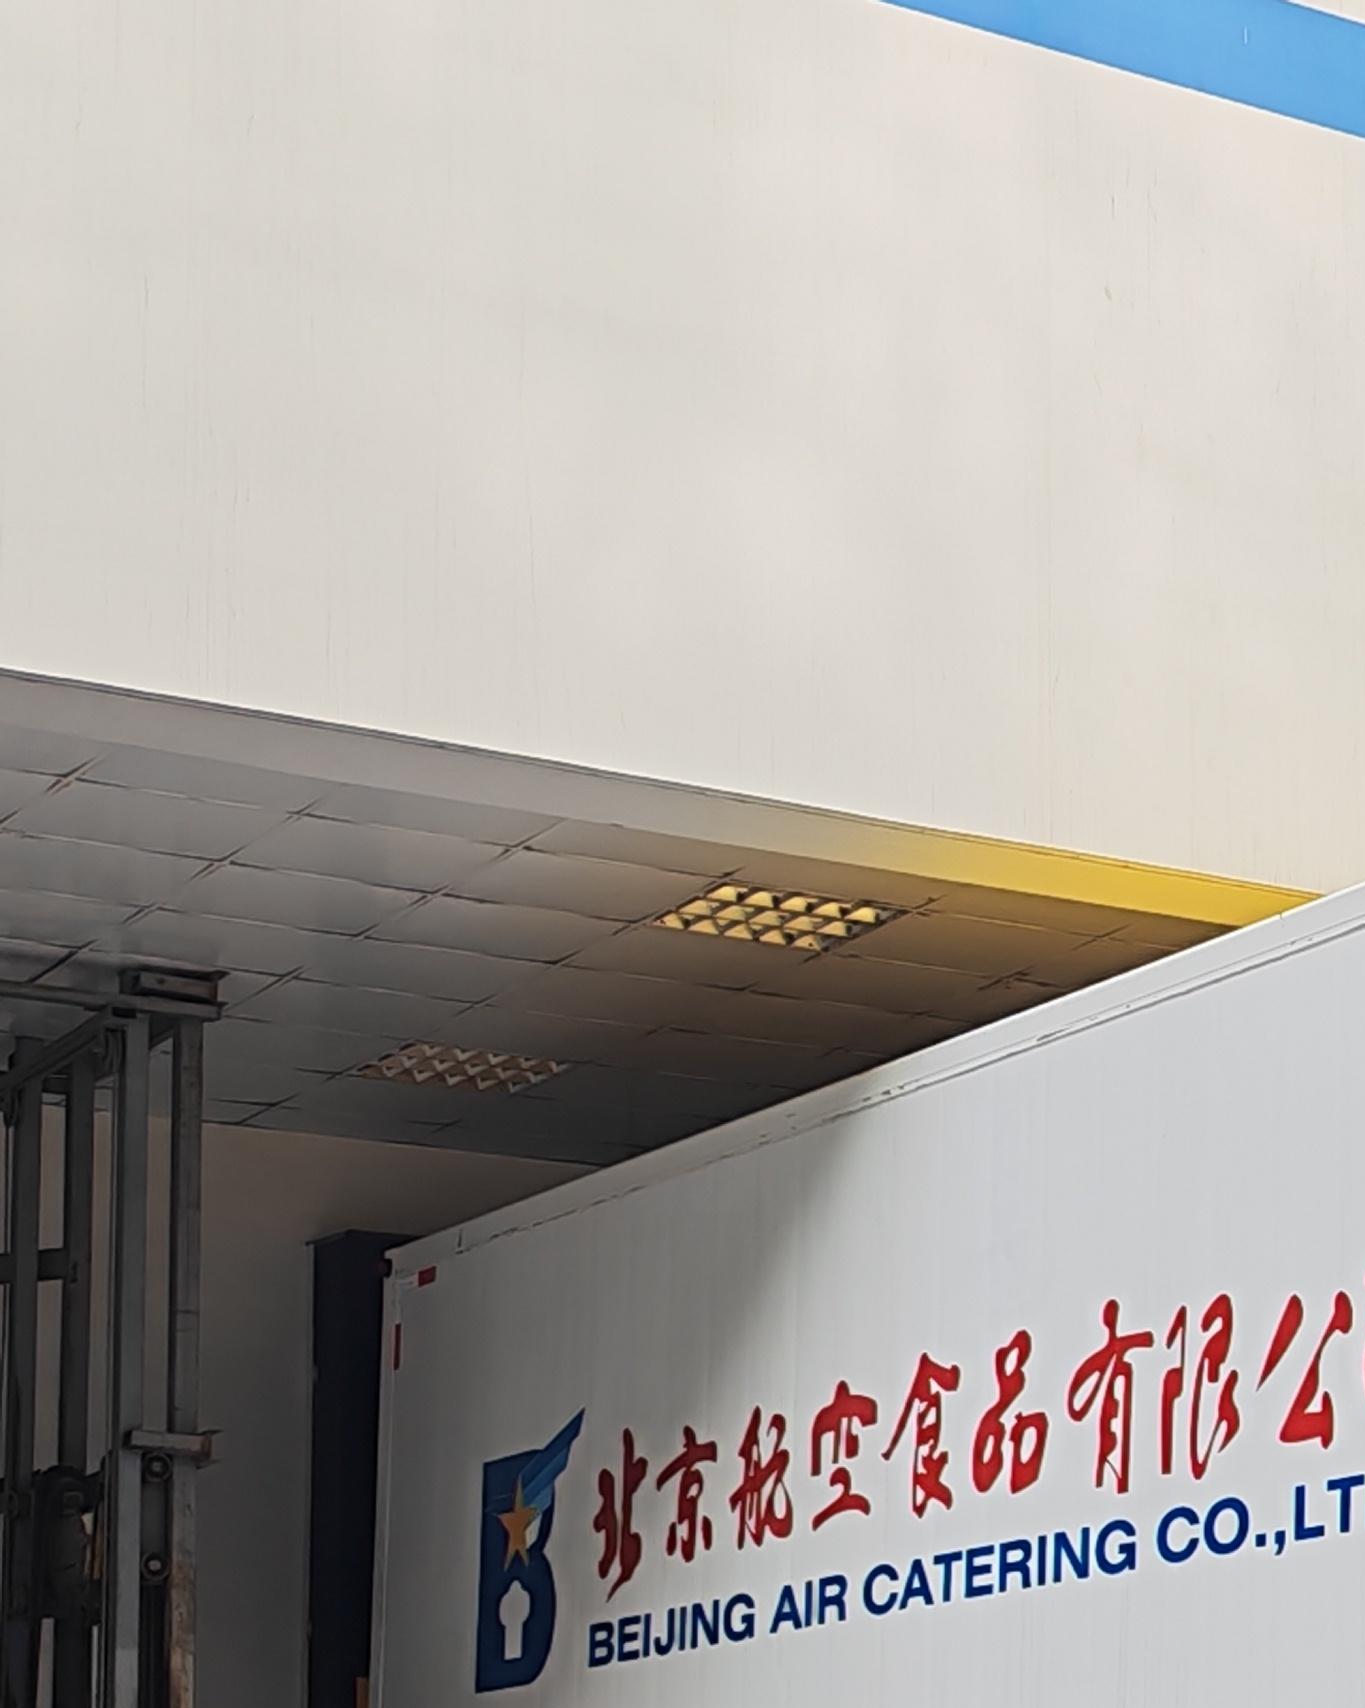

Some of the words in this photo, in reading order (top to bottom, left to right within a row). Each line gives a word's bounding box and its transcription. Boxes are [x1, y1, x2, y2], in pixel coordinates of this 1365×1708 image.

[588, 1592, 755, 1668] BEIJING
[769, 1574, 848, 1634] AIR
[862, 1519, 1136, 1616] CATERING
